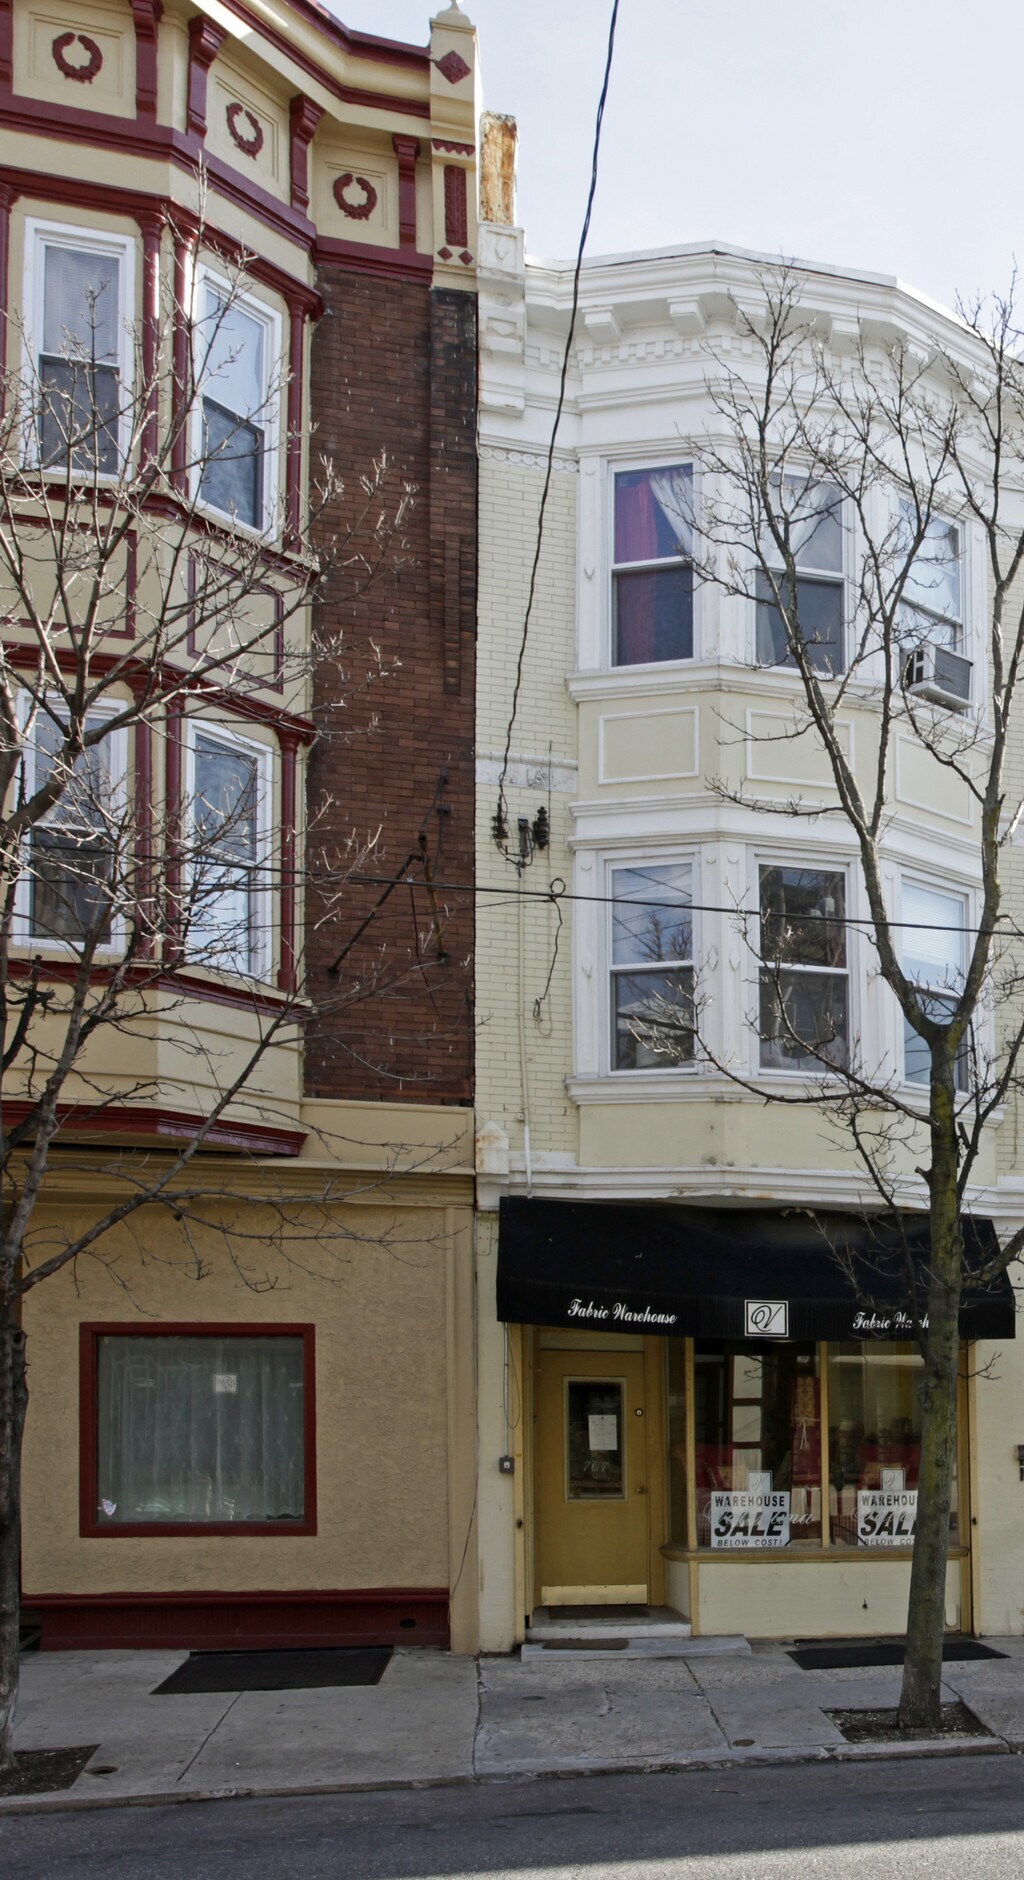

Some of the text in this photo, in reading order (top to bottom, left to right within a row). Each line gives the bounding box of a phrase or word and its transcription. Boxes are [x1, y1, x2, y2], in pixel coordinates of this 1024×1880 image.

[567, 1298, 679, 1325] Fabric Warehouse
[852, 1311, 892, 1329] Fabric
[714, 1495, 786, 1508] WAREHOUSE
[861, 1494, 916, 1507] WAREHOU
[713, 1511, 788, 1538] SALE
[716, 1538, 783, 1547] BELOW COST!
[864, 1538, 895, 1546] BELOW
